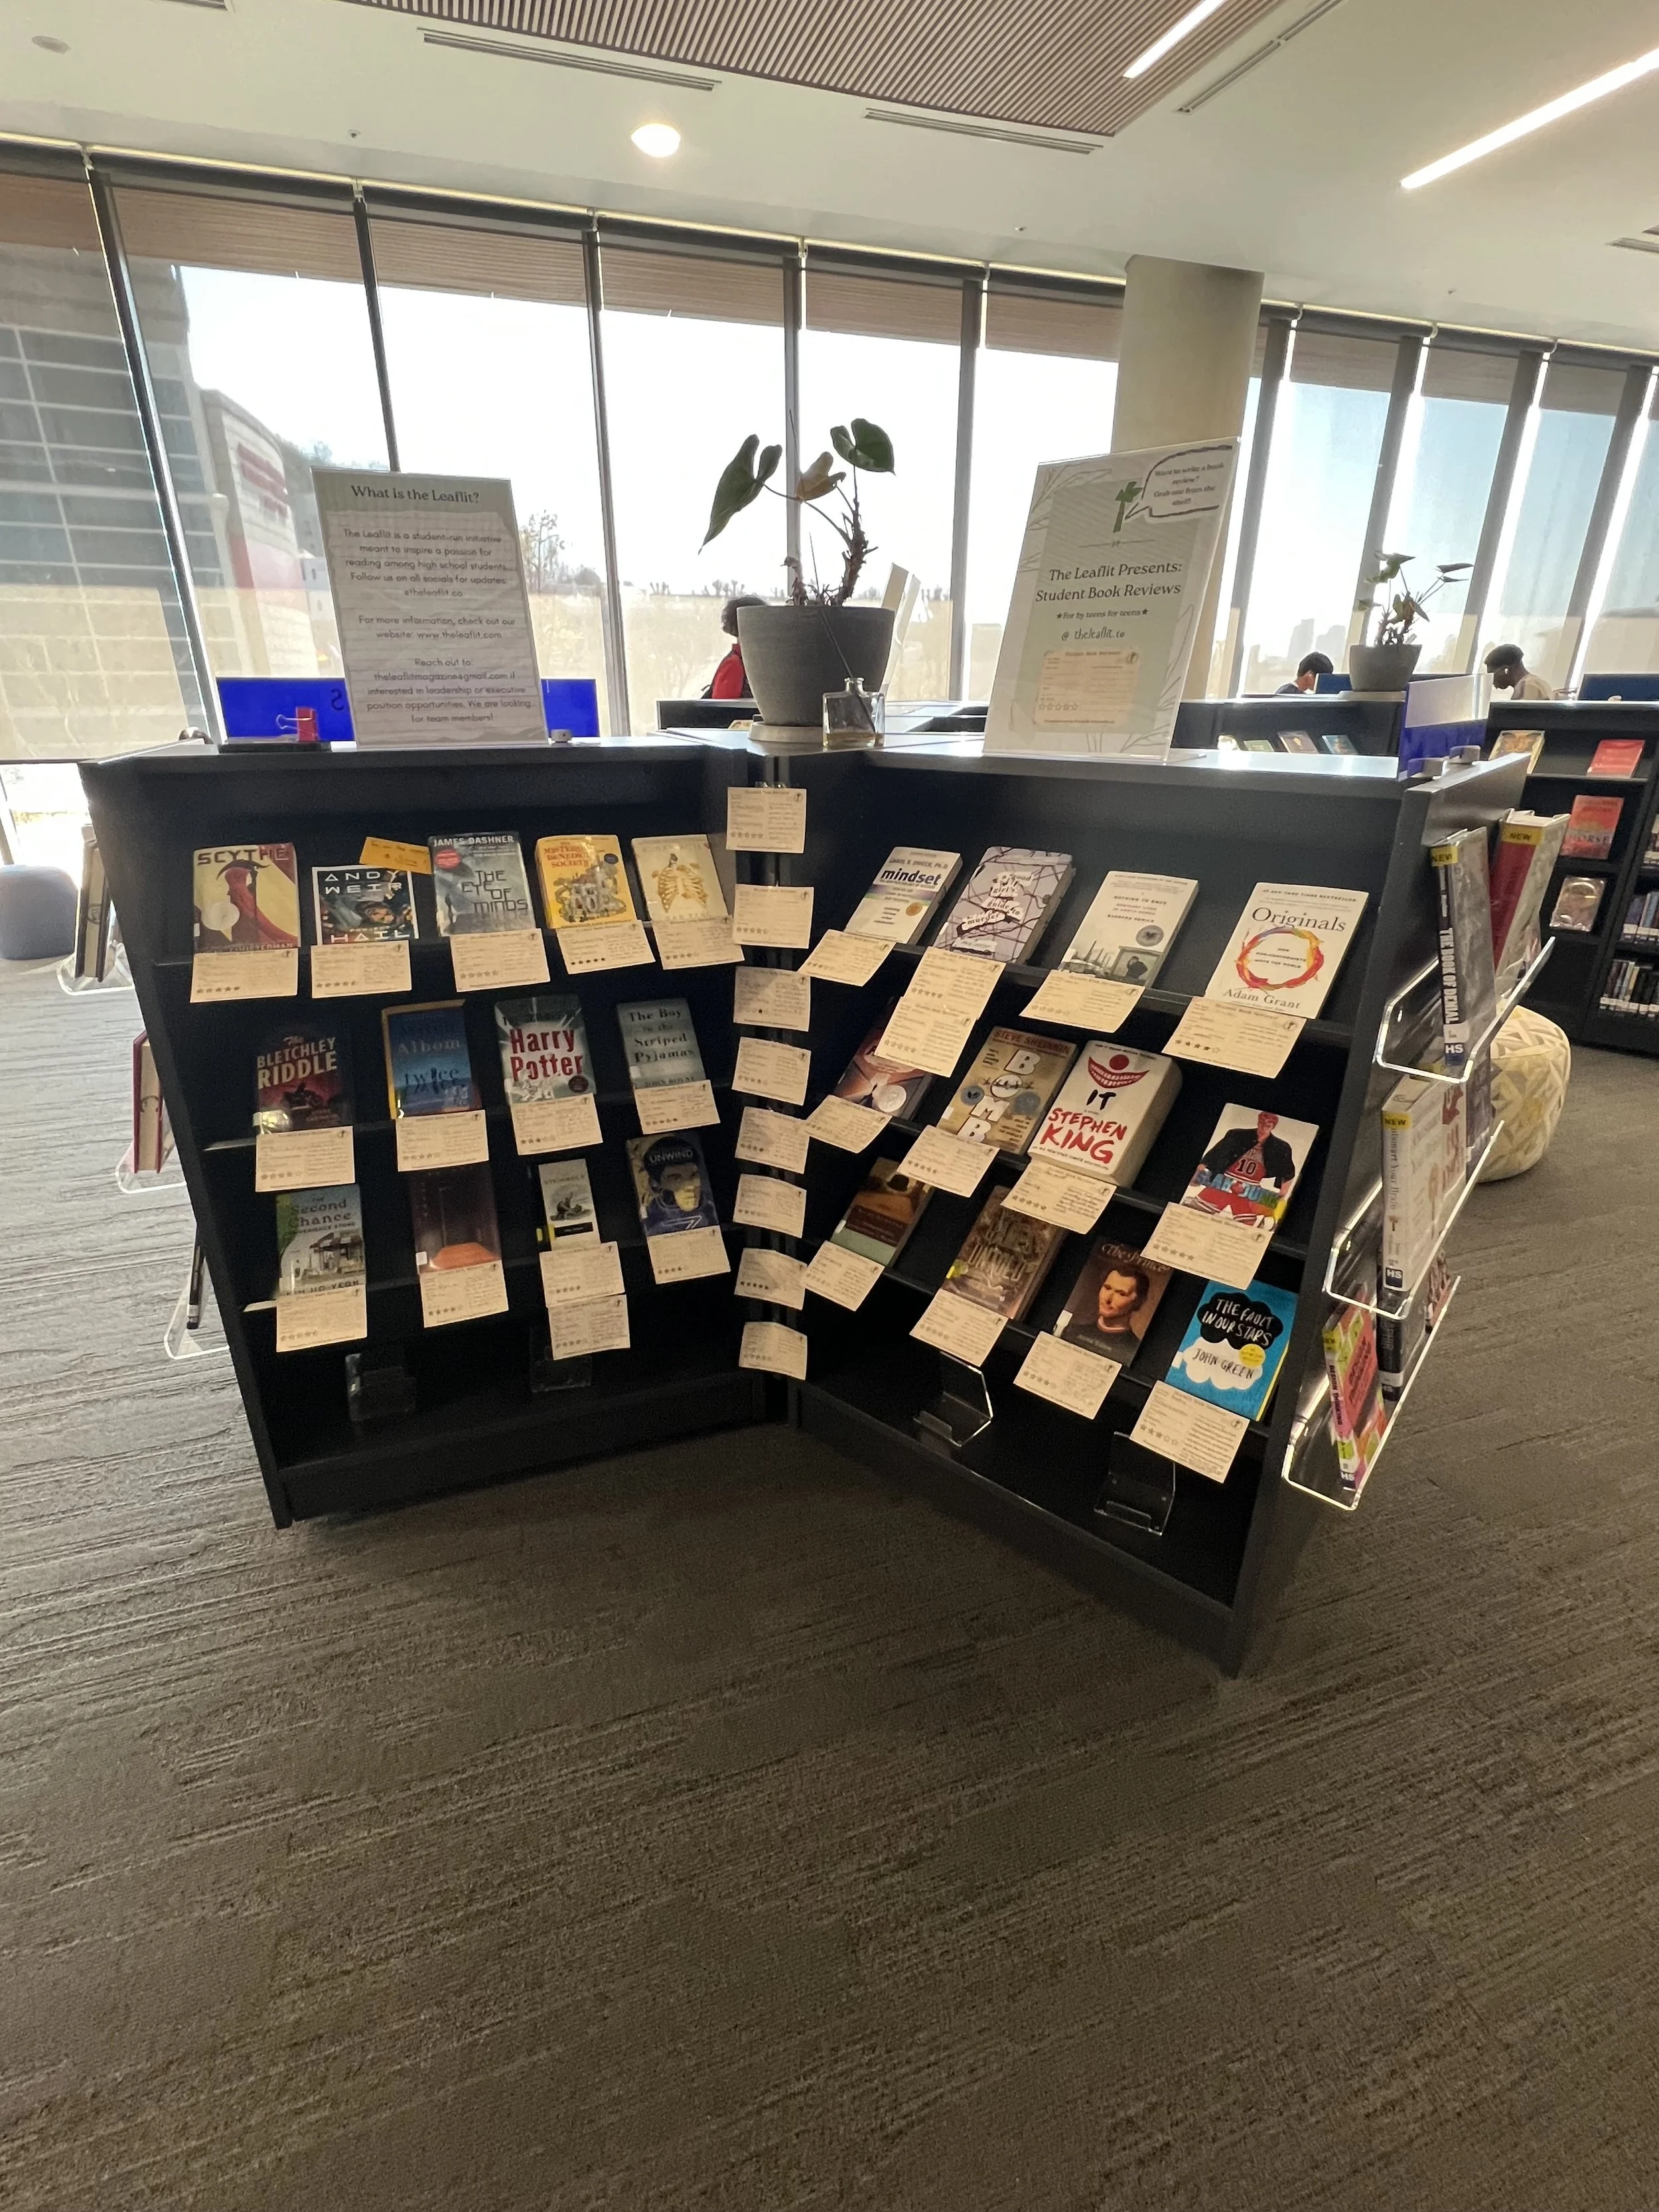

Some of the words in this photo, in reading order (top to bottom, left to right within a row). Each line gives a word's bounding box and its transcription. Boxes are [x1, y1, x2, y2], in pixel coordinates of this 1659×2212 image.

[351, 485, 390, 498] What
[394, 488, 404, 499] is
[407, 490, 429, 500] the
[433, 490, 479, 503] Leaflit?
[343, 528, 360, 538] The
[394, 530, 401, 539] is
[412, 532, 463, 542] student-run
[403, 546, 433, 556] inspire
[445, 548, 476, 557] passion
[479, 547, 492, 556] for
[346, 558, 381, 569] reading
[384, 561, 415, 570] among
[418, 559, 437, 571] high
[439, 559, 468, 569] school
[1049, 569, 1072, 581] The
[1074, 565, 1115, 580] Leaflit
[1118, 562, 1183, 576] Presents:
[350, 572, 381, 581] Follow
[410, 573, 420, 582] all
[423, 574, 453, 583] socials
[1035, 589, 1086, 602] Student
[1088, 585, 1121, 599] Book
[1123, 583, 1181, 597] Reviews
[358, 615, 374, 624] For
[458, 617, 483, 625] check
[414, 658, 443, 666] Reach
[510, 671, 516, 680] if
[368, 686, 413, 696] interested
[426, 685, 472, 696] leadership
[485, 685, 526, 694] executive
[367, 701, 403, 711] position
[468, 700, 482, 708] We
[501, 699, 531, 709] looking
[452, 713, 493, 722] members!
[433, 838, 465, 847] JAMES
[469, 835, 514, 845] DASHNER
[1510, 832, 1532, 841] NEW
[197, 844, 289, 865] SCYTHE
[1432, 853, 1452, 862] NEW
[325, 869, 399, 883] ANDY
[475, 870, 507, 886] THE
[881, 868, 942, 885] mindset
[325, 883, 402, 895] WEIR
[461, 881, 492, 895] EYE
[490, 888, 512, 901] OF
[993, 885, 1015, 894] girl's
[473, 899, 528, 914] MINDS
[968, 914, 999, 924] murder
[1252, 907, 1346, 932] Originals
[330, 930, 410, 943] HAIL
[1223, 988, 1259, 1002] Adam
[1263, 994, 1301, 1009] Grant
[628, 1011, 653, 1021] The
[659, 1008, 681, 1018] Boy
[283, 1035, 304, 1046] The
[510, 1028, 575, 1055] Harry
[634, 1033, 687, 1047] Striped
[993, 1030, 1024, 1043] STEVE
[257, 1037, 336, 1070] BLETCHLEY
[399, 1040, 460, 1054] Albom
[1445, 1044, 1464, 1053] HS
[634, 1050, 694, 1063] Pyjamas
[258, 1051, 338, 1090] RIDDLE
[510, 1053, 584, 1082] Potter
[1086, 1089, 1116, 1110] IT
[1048, 1107, 1127, 1141] STEPHEN
[1040, 1123, 1115, 1164] KING
[649, 1149, 693, 1163] UNWIND
[1236, 1159, 1256, 1175] 10
[291, 1199, 347, 1214] Second
[288, 1213, 352, 1228] Chance
[1102, 1244, 1126, 1259] The
[1124, 1252, 1171, 1272] Prince
[1386, 1268, 1402, 1278] HS
[1216, 1299, 1241, 1315] THE
[1240, 1308, 1274, 1329] FAULT
[1202, 1311, 1217, 1325] IN
[1215, 1317, 1236, 1333] OUR
[1235, 1323, 1272, 1347] STARS
[1192, 1349, 1218, 1365] JOHN
[1221, 1360, 1255, 1379] GREEN
[1329, 1364, 1338, 1390] DESIGN
[1333, 1392, 1343, 1426] THINKING
[1340, 1472, 1354, 1481] HS
